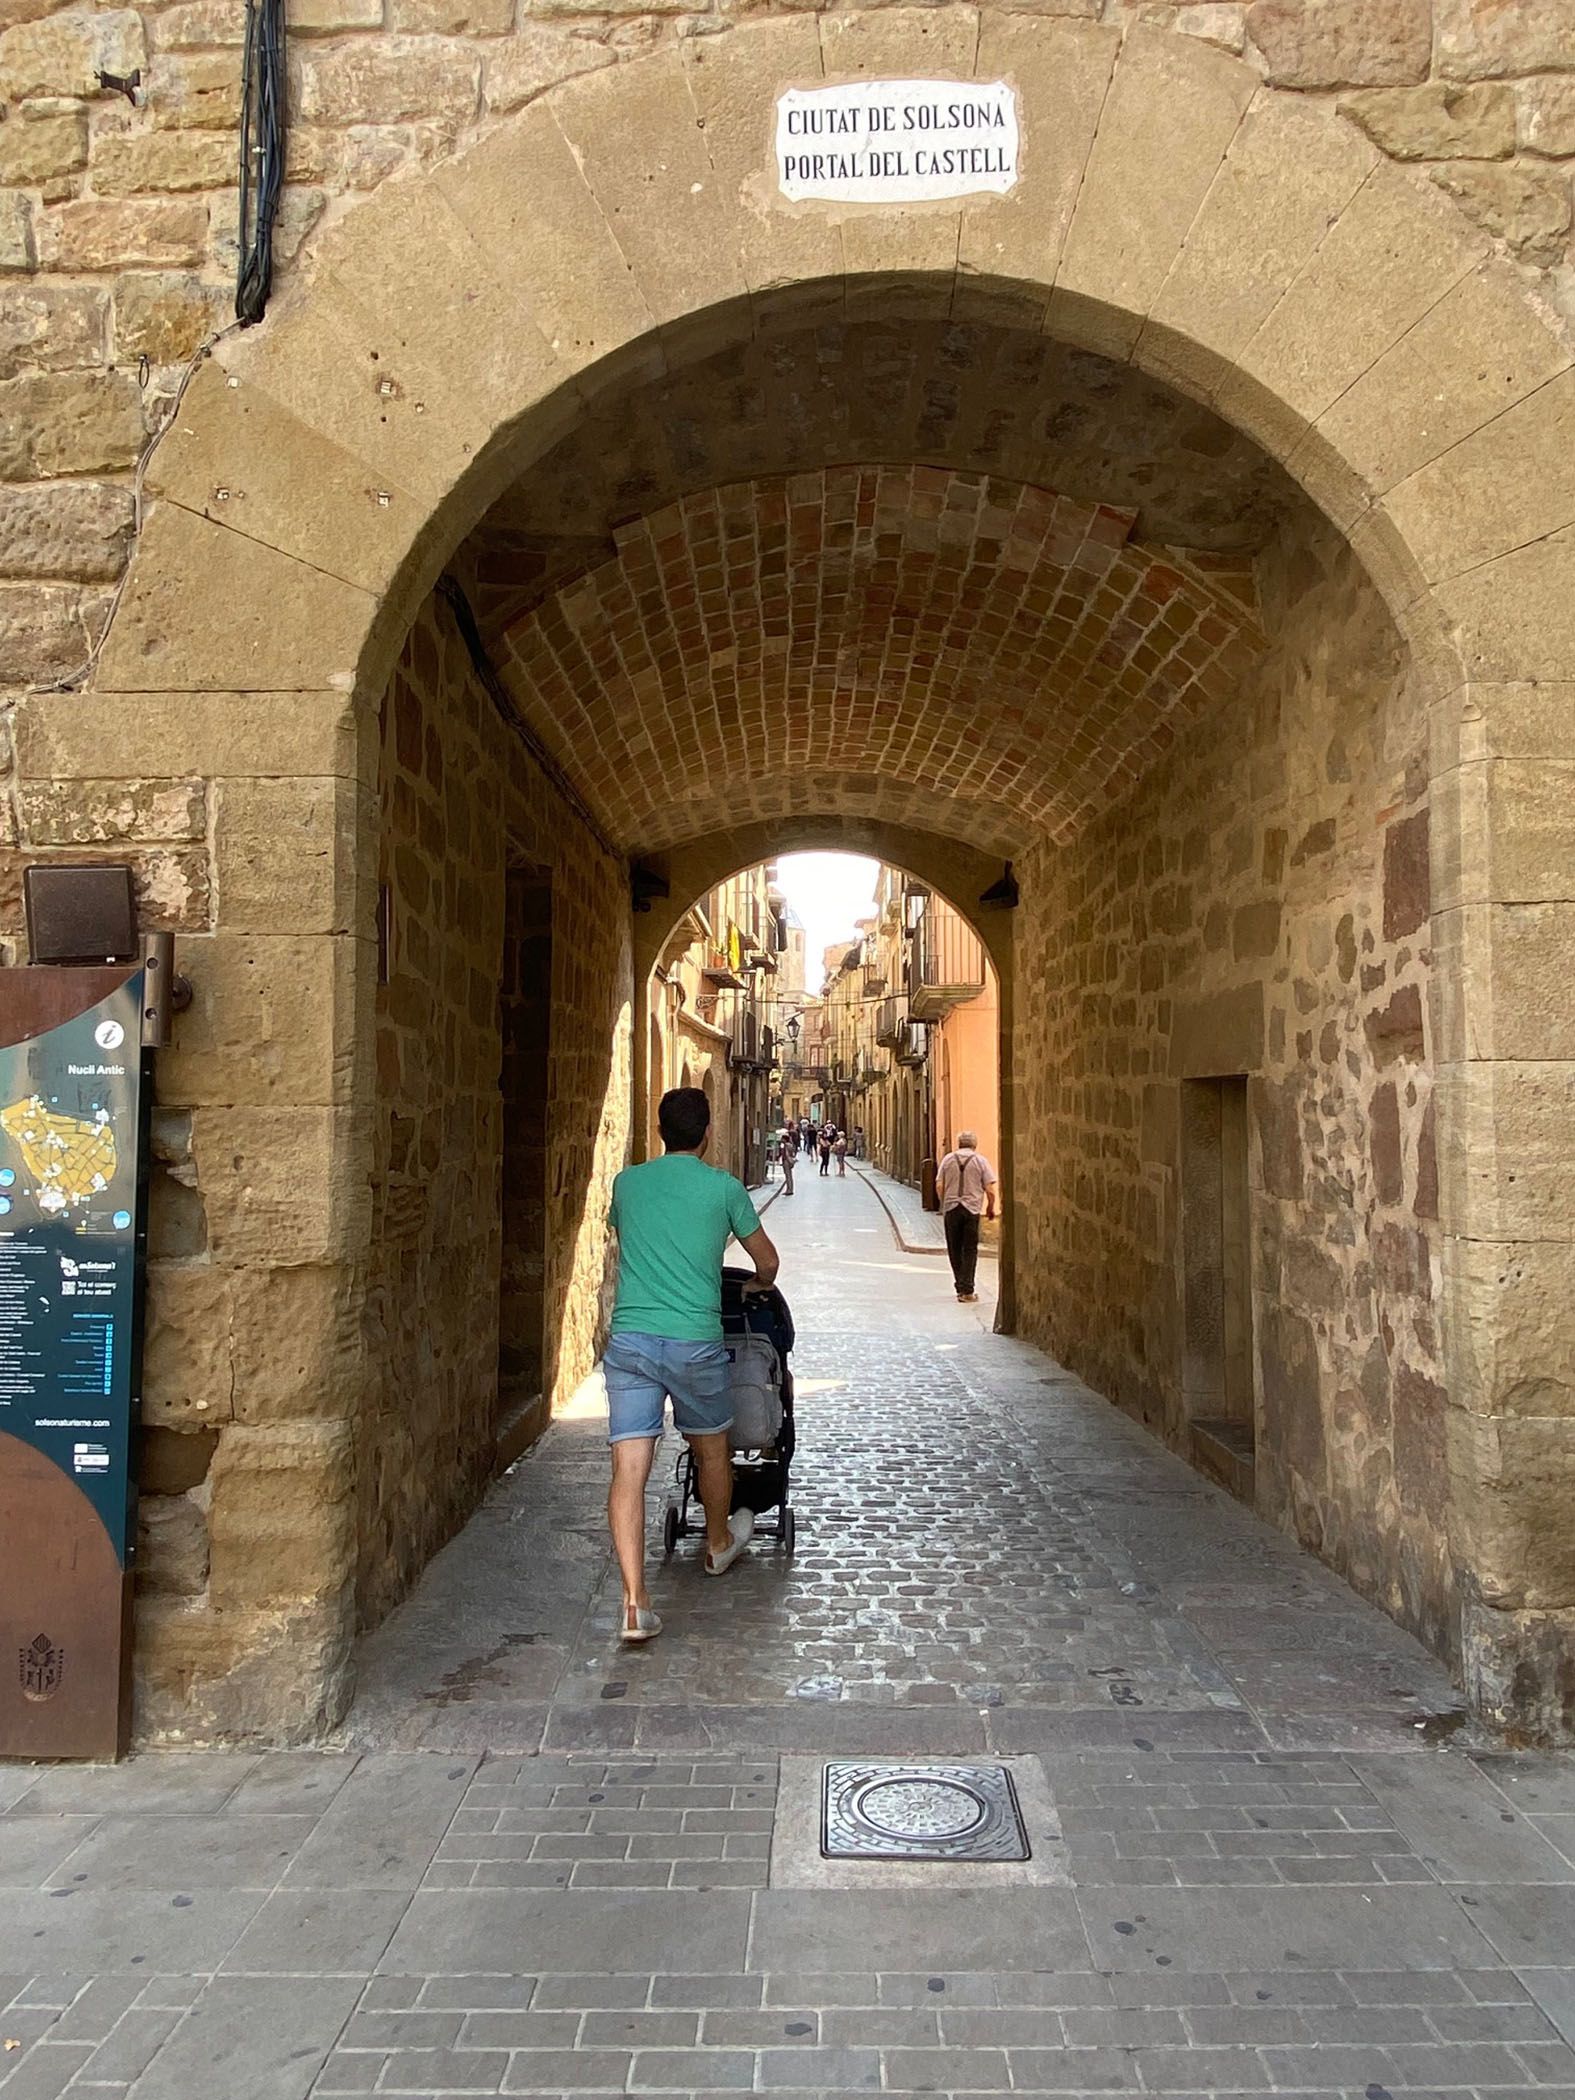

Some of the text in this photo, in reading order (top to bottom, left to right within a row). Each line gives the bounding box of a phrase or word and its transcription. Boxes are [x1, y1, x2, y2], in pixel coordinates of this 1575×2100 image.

[788, 102, 1005, 135] CIUTAT DE SOLSONA
[784, 147, 1011, 181] PORTAL DEL CASTELL
[68, 1064, 125, 1074] Nucli Antic
